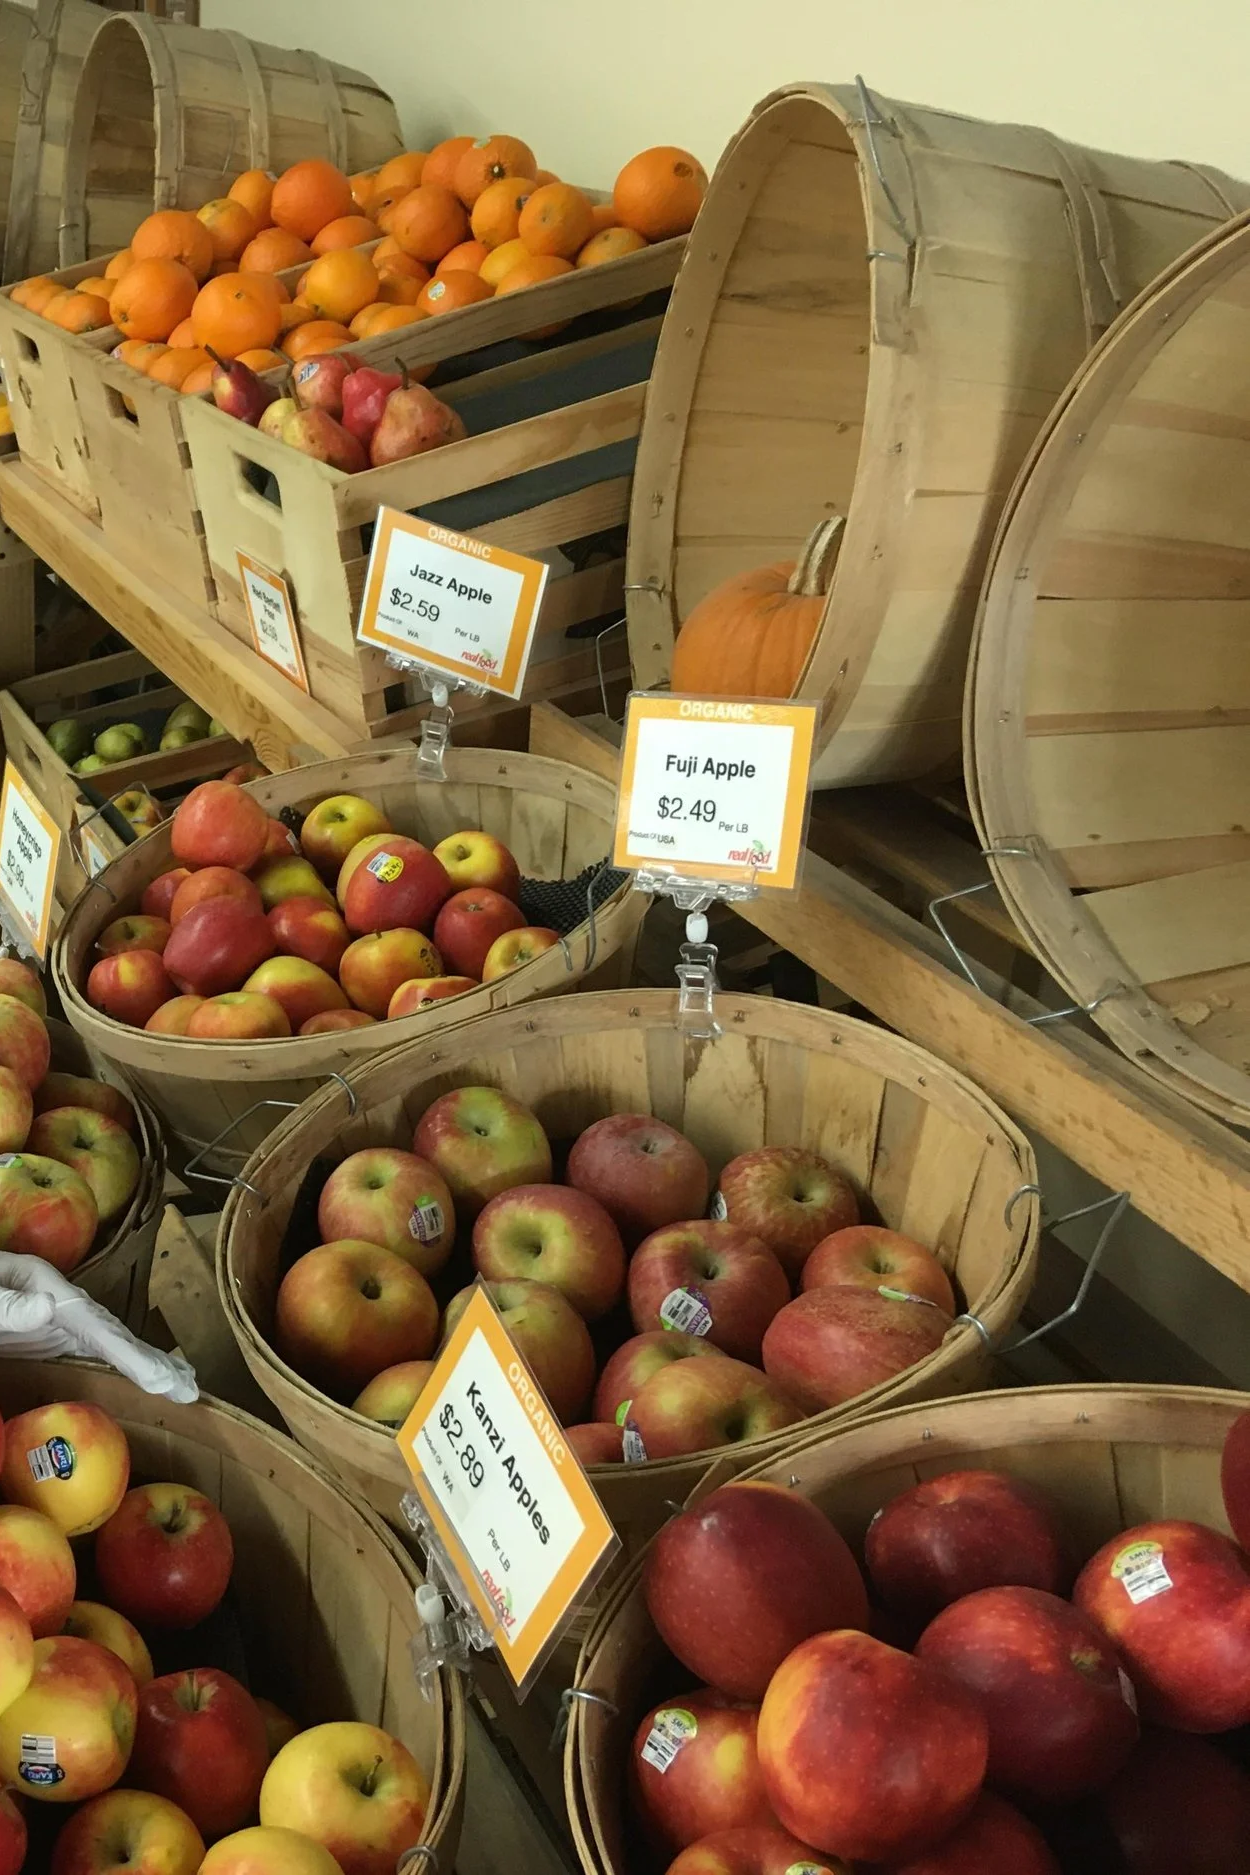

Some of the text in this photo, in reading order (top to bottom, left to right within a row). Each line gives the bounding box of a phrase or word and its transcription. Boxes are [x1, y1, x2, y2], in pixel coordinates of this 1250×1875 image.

[428, 526, 492, 559] ORGANIC
[410, 564, 492, 604] Jazz Apple
[390, 587, 440, 622] $2.59
[407, 629, 419, 639] WA
[454, 627, 481, 643] Per LB
[679, 702, 755, 720] ORGANIC
[665, 754, 756, 781] Fuji Apple
[657, 795, 717, 823] $2.49
[12, 807, 43, 859] Honeycrisp
[657, 834, 675, 845] USA
[718, 821, 749, 833] Per LB
[16, 835, 33, 864] Apple
[6, 849, 25, 888] $2.99
[508, 1361, 566, 1465] ORGANIC
[55, 1444, 68, 1468] KANZI
[466, 1380, 550, 1545] Kanzi Apples
[439, 1403, 511, 1572] $2.89 Per LB
[442, 1470, 454, 1494] WA
[28, 1771, 53, 1779] KANZI
